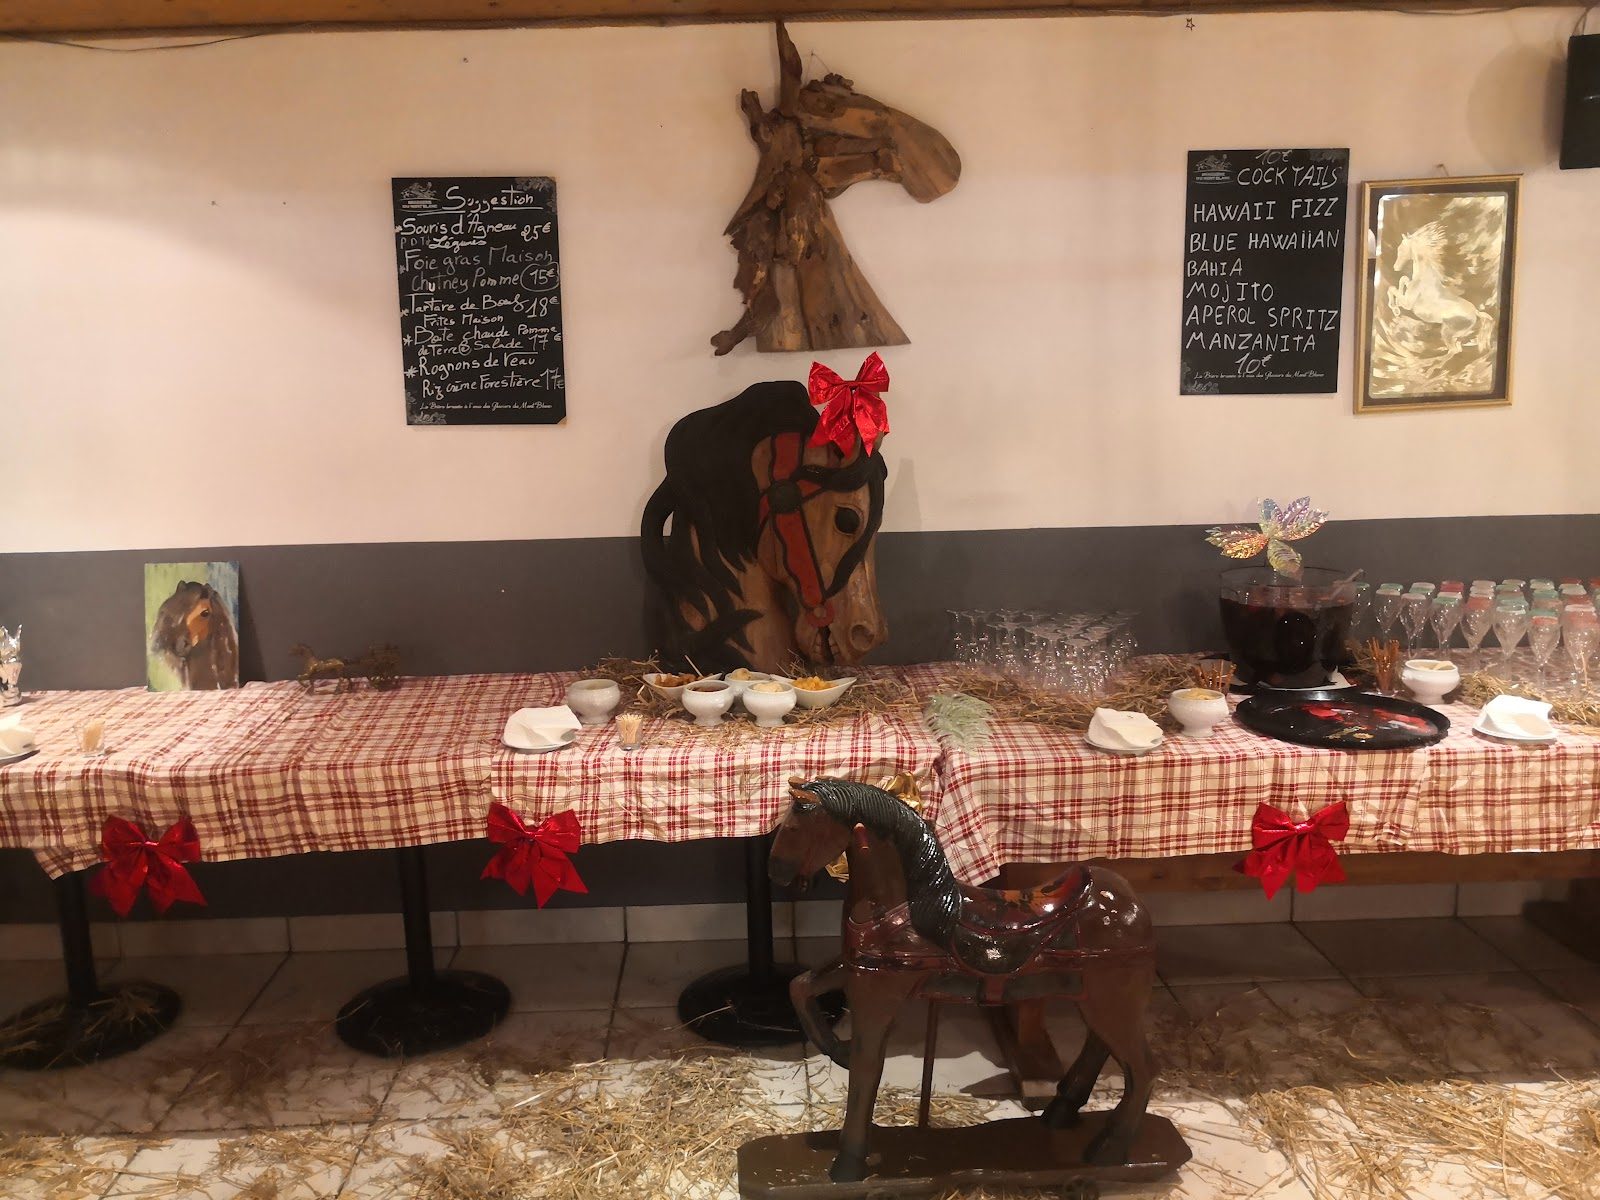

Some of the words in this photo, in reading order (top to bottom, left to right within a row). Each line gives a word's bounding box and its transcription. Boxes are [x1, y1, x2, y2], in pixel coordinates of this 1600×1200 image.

[442, 184, 534, 214] Suggestion
[1193, 201, 1276, 223] HAWAII
[1290, 197, 1339, 219] FIZZ
[401, 217, 448, 235] Souris
[521, 222, 551, 242] 25€
[1189, 232, 1238, 253] BLUE
[404, 248, 438, 271] Foie
[442, 254, 481, 275] gras
[488, 245, 553, 265] Maison
[1187, 258, 1243, 277] BAHIA
[472, 266, 520, 288] Pomme
[530, 268, 555, 286] 15€
[405, 293, 457, 314] Tartare
[460, 297, 480, 311] de
[525, 296, 560, 318] 18€
[423, 314, 456, 328] Frites
[462, 314, 504, 326] Maison
[1186, 304, 1256, 326] APEROL
[1268, 307, 1339, 331] SPRITZ
[1186, 331, 1316, 352] MANZANITA
[419, 356, 480, 380] Rognons
[484, 352, 499, 368] de
[1235, 352, 1273, 374] 10€
[422, 379, 444, 400] Riz
